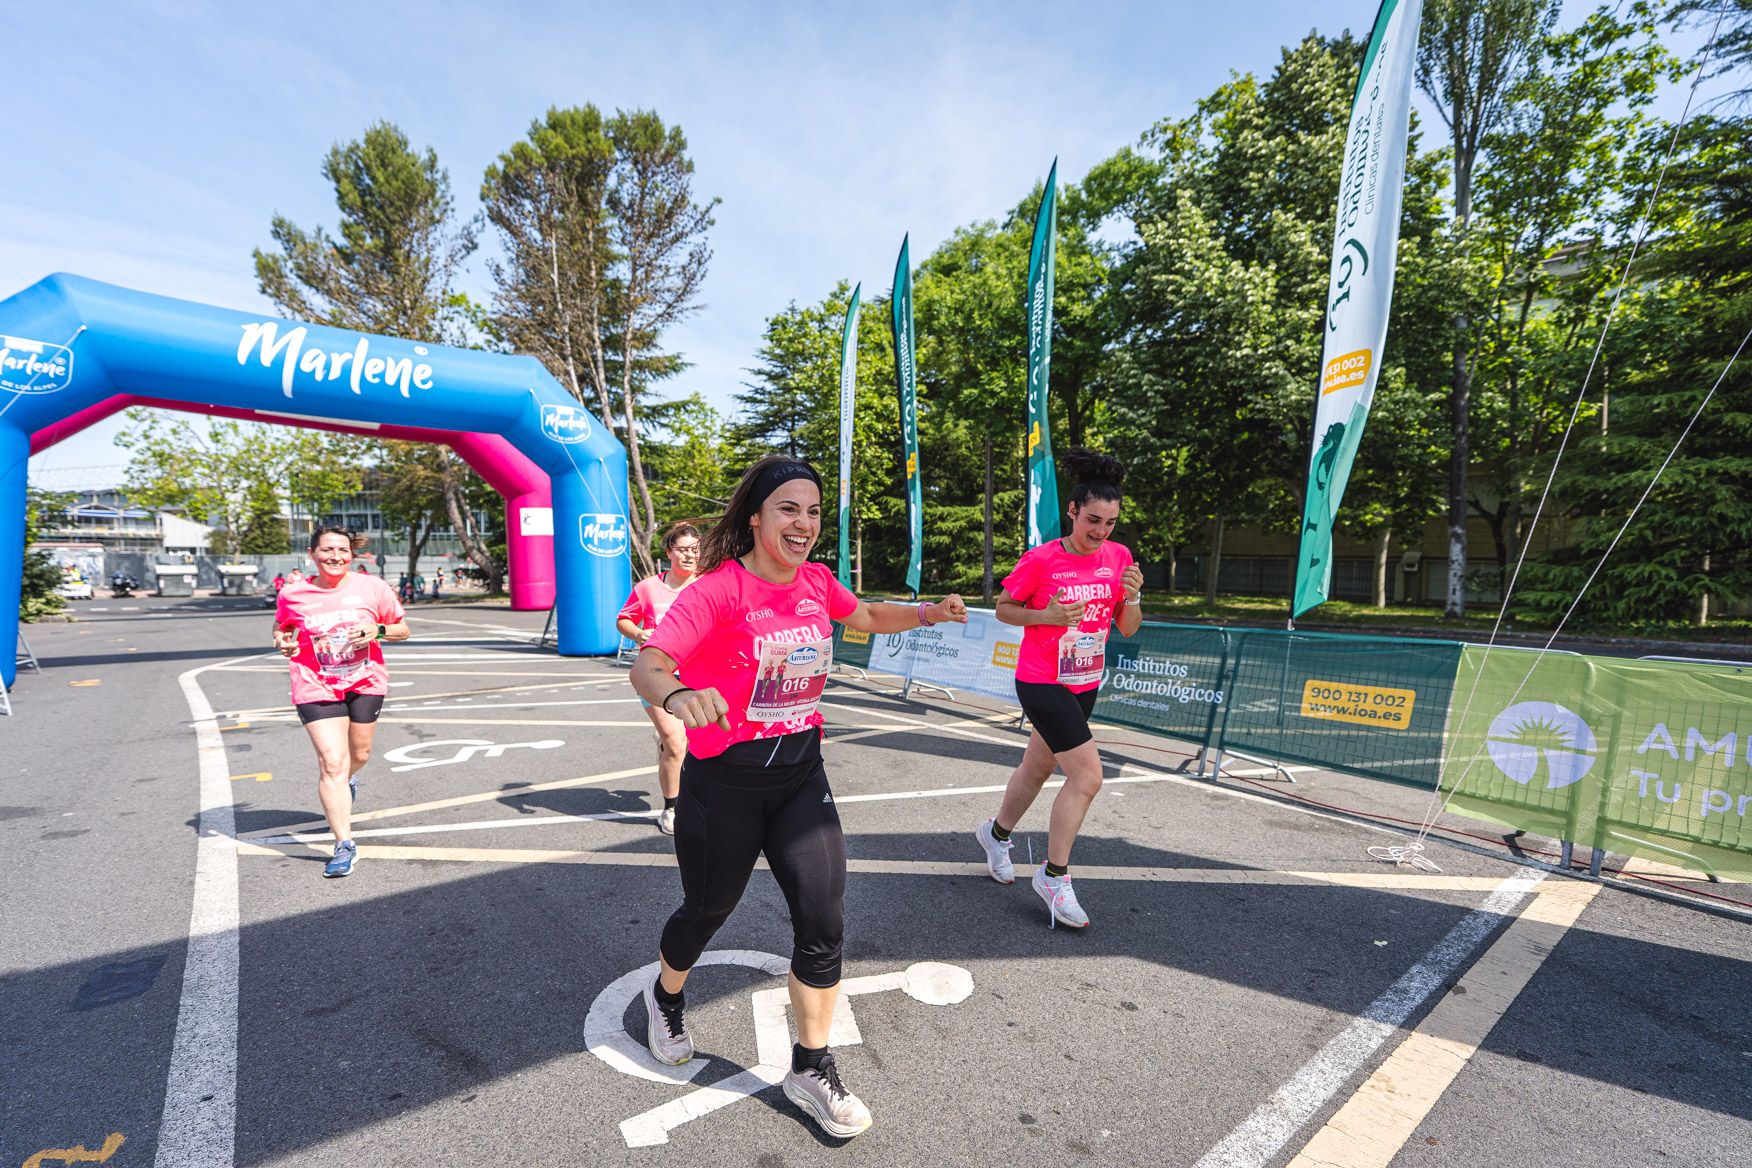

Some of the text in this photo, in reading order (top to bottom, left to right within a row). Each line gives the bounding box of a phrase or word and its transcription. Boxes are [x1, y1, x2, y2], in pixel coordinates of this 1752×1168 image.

[236, 320, 434, 399] Marlene
[1341, 355, 1366, 371] 002
[1052, 571, 1077, 580] OYSHO
[745, 608, 774, 622] OYSHO
[905, 639, 960, 658] Odontológicos
[1075, 656, 1093, 667] 016
[1115, 653, 1189, 679] Institutos
[781, 677, 810, 693] 016
[1113, 673, 1225, 705] Odontológicos
[1136, 697, 1170, 712] dentales
[1311, 687, 1407, 708] 900 131 002
[1308, 702, 1403, 722] www.ioa.es
[1630, 769, 1681, 804] Tu
